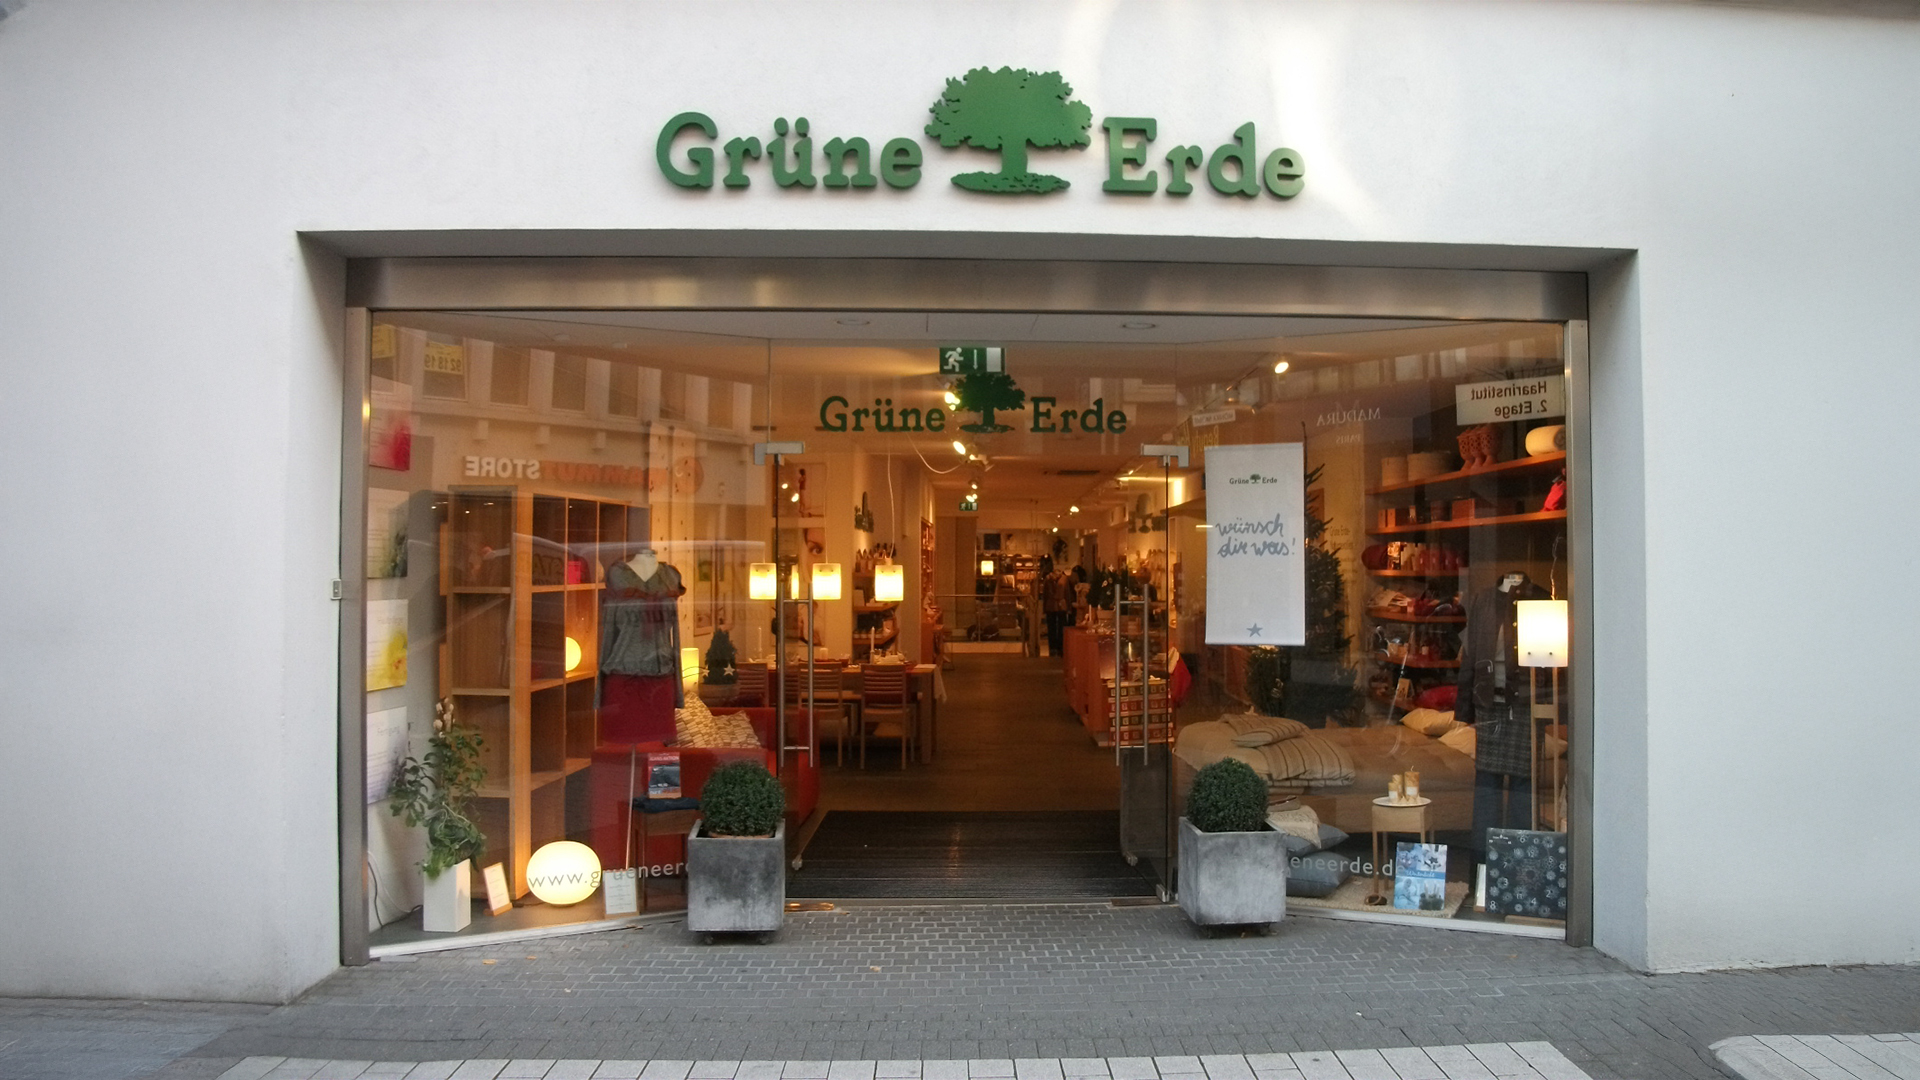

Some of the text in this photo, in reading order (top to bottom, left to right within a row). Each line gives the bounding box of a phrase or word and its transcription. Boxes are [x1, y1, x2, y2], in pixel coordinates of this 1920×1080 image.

[656, 111, 1306, 199] Grüne Erde
[819, 395, 1128, 434] Grüne Erde
[1215, 513, 1284, 537] wünsch
[1217, 536, 1248, 558] dir
[529, 860, 688, 888] www.grueneer
